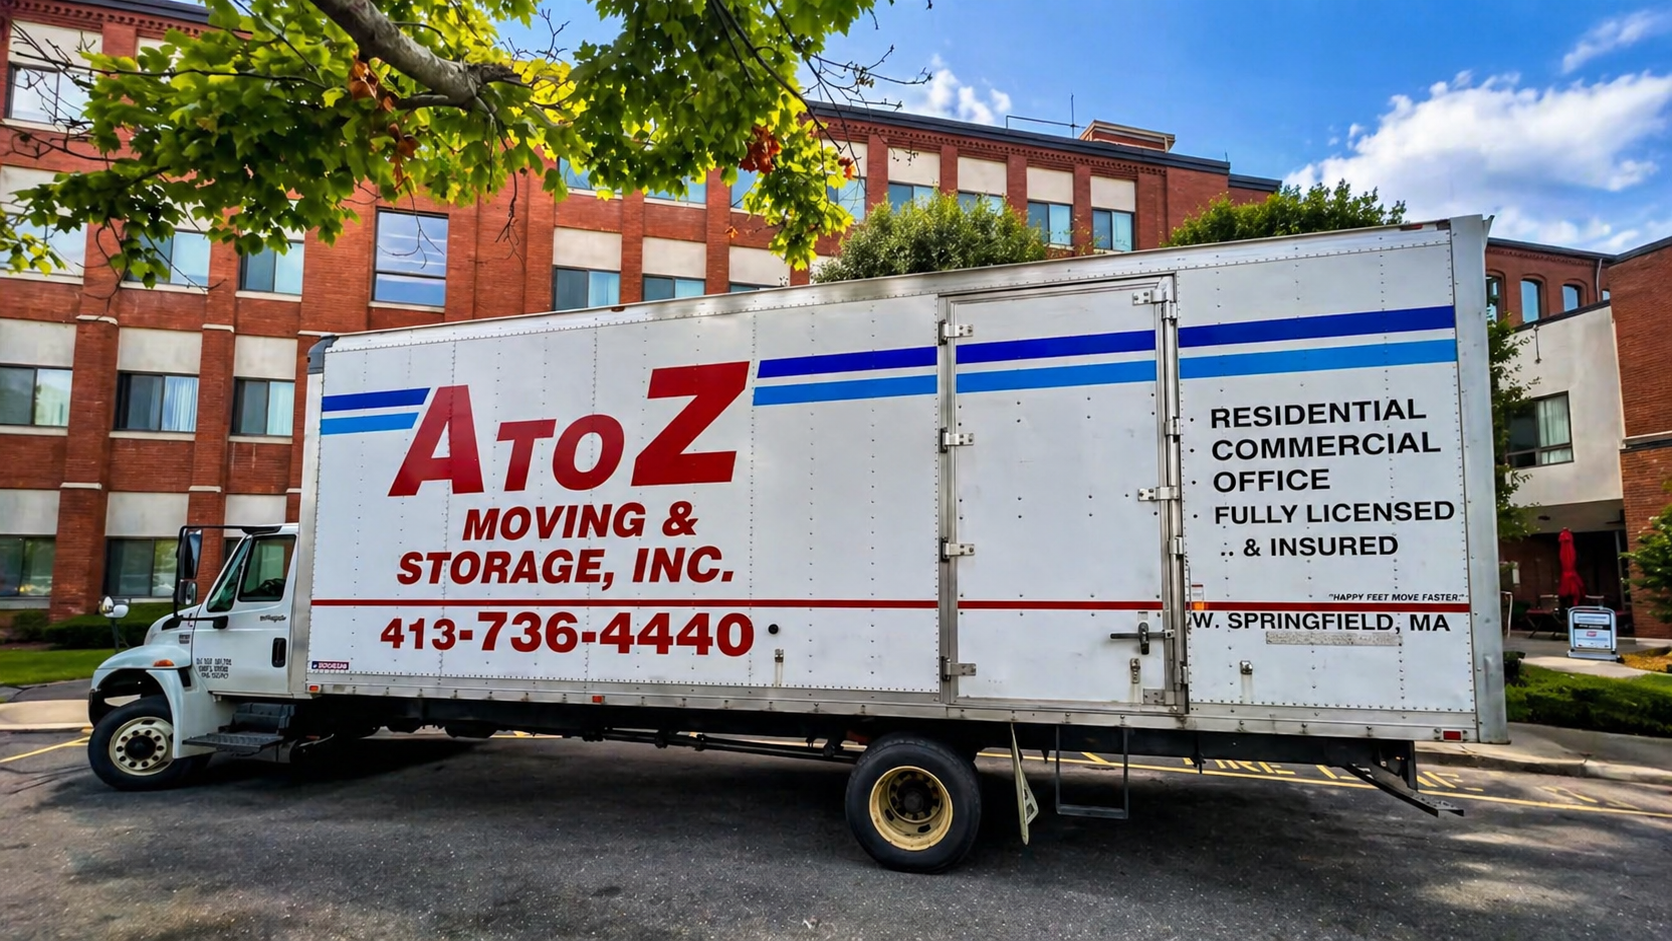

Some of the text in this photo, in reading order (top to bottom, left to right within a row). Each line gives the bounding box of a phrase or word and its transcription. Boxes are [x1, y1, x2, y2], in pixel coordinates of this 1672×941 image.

[388, 360, 749, 496] A TO Z
[1210, 399, 1427, 429] RESIDENTIAL
[1211, 432, 1442, 461] COMMERCIAL
[1213, 469, 1331, 493] OFFICE
[463, 500, 697, 541] MOVING &
[1215, 501, 1455, 525] FULLY LICENSED
[1243, 536, 1399, 557] & INSURED
[397, 546, 734, 591] STORAGE, INC.
[1366, 593, 1390, 601] FEET
[1391, 593, 1420, 601] MOVE
[381, 611, 755, 657] 413-736-4440
[1192, 612, 1451, 635] W. SPRINGFIELD, MA
